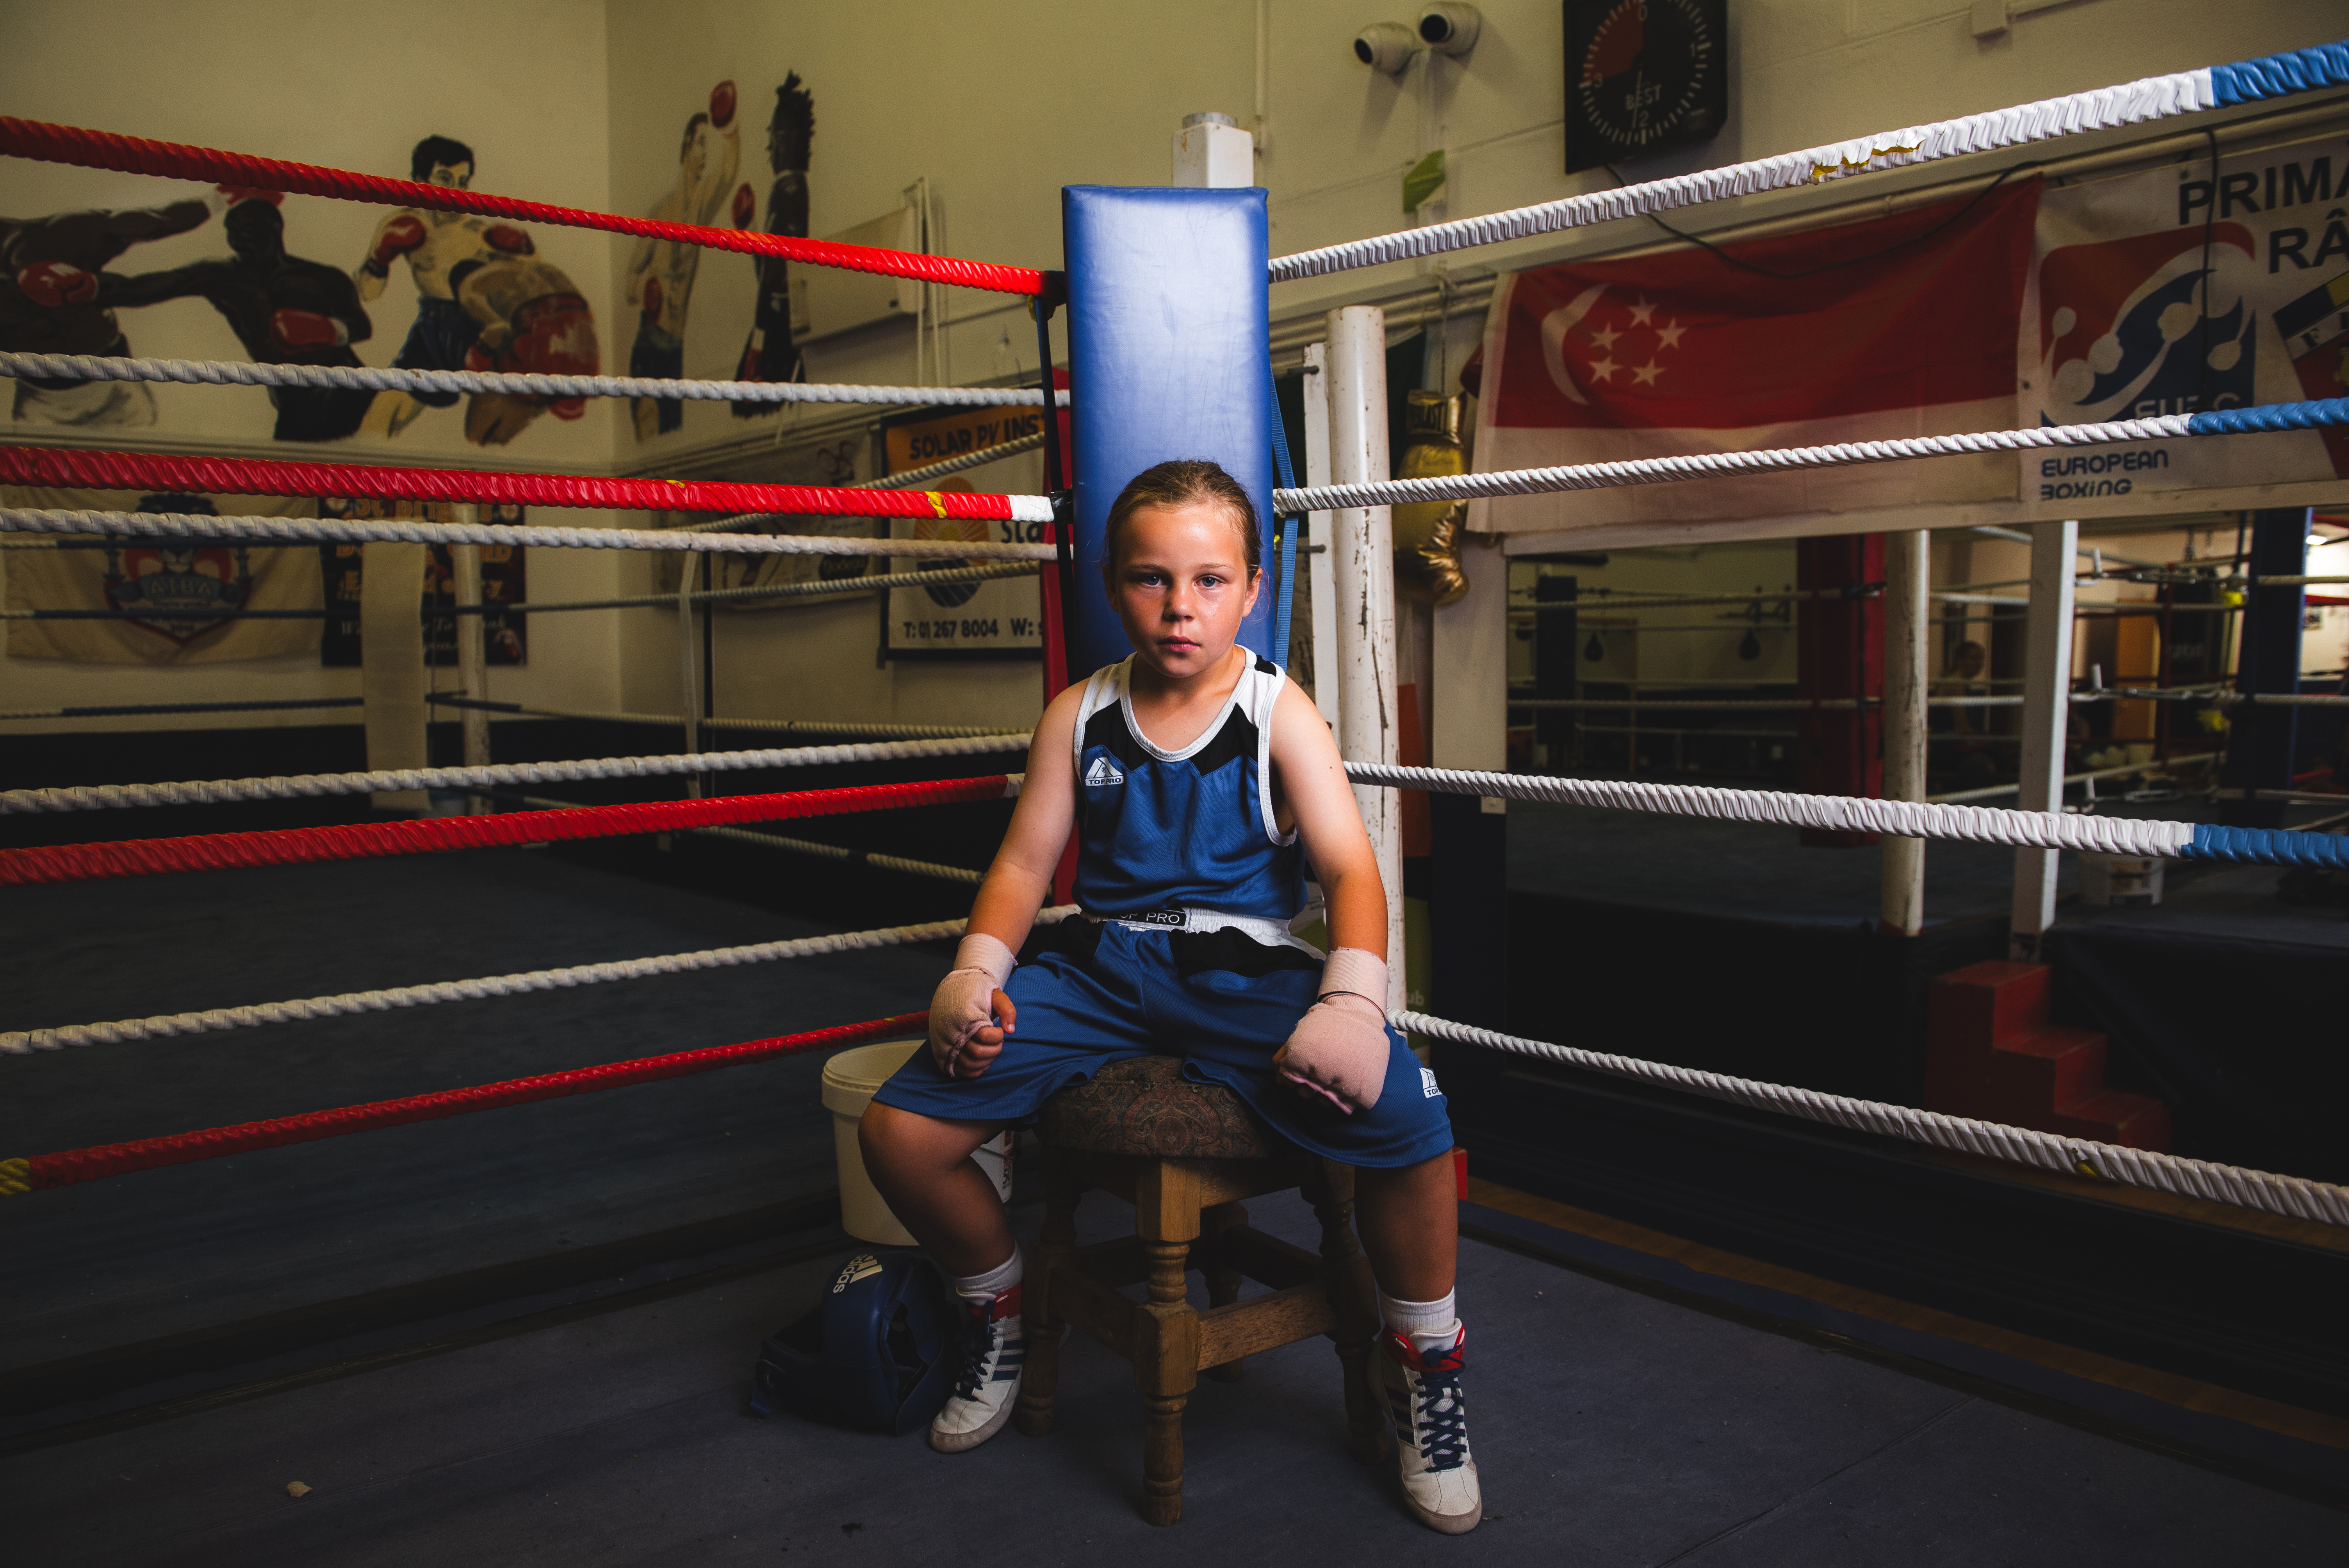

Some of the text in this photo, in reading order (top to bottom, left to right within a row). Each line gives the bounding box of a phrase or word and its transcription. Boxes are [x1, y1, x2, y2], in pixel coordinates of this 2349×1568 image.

[1637, 4, 1648, 22] 0
[1689, 41, 1696, 58] 1
[1639, 110, 1649, 128] 2
[909, 414, 1045, 460] SOLAR PV INS
[2041, 449, 2169, 477] EUROPEAN
[151, 577, 212, 595] AIBA
[904, 618, 1033, 638] T: 01 267 8004 W:
[1146, 912, 1180, 924] PRO
[832, 1254, 868, 1294] adidas
